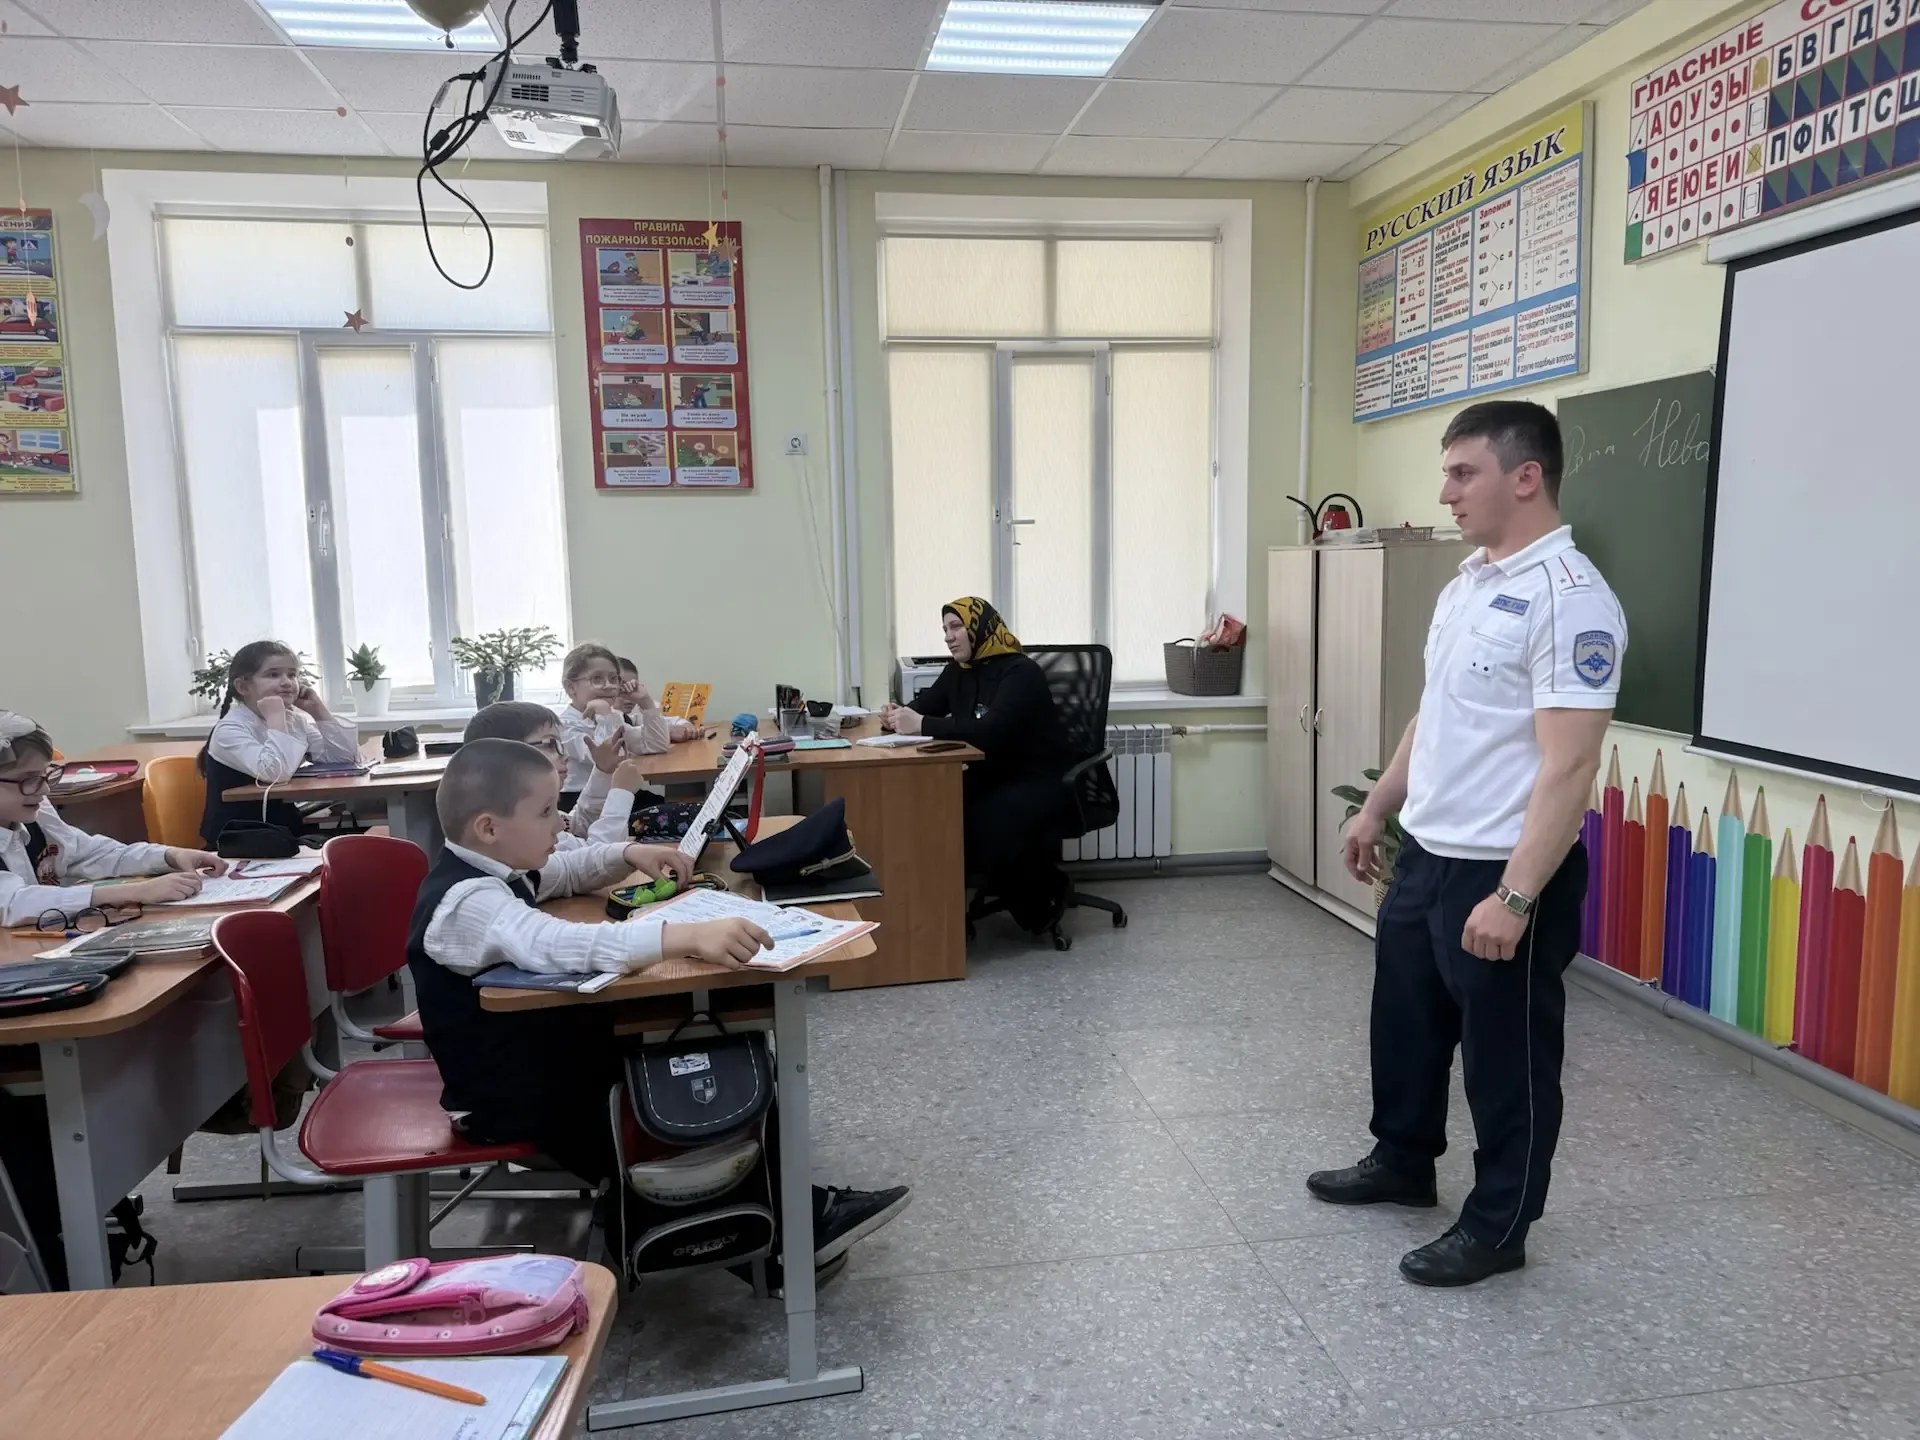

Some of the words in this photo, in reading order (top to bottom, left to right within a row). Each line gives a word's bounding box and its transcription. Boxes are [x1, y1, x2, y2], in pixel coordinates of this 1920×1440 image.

[1634, 22, 1764, 108] ГЛАСНЫЕ
[1778, 44, 1793, 79] Б
[1801, 32, 1817, 67] В
[1829, 18, 1845, 54] Г
[1853, 4, 1874, 47] Д
[1650, 110, 1662, 139] А
[1669, 100, 1682, 128] О
[1690, 88, 1702, 120] У
[1710, 79, 1723, 109] Э
[1728, 66, 1748, 101] Ы
[1770, 132, 1787, 165] П
[1793, 122, 1812, 153] Ф
[1821, 109, 1838, 145] К
[1850, 98, 1866, 133] Т
[1874, 87, 1892, 122] С
[1366, 172, 1476, 252] РУССКИЙ
[1478, 127, 1565, 195] ЯЗЫК
[1480, 199, 1512, 220] Запомни
[1647, 183, 1659, 215] Я
[1667, 175, 1678, 206] Ё
[1683, 169, 1699, 200] Ю
[1705, 160, 1718, 191] Е
[1725, 151, 1740, 183] И
[585, 233, 649, 246] ПОЖАРНОЙ
[634, 221, 686, 233] ПРАВИЛА
